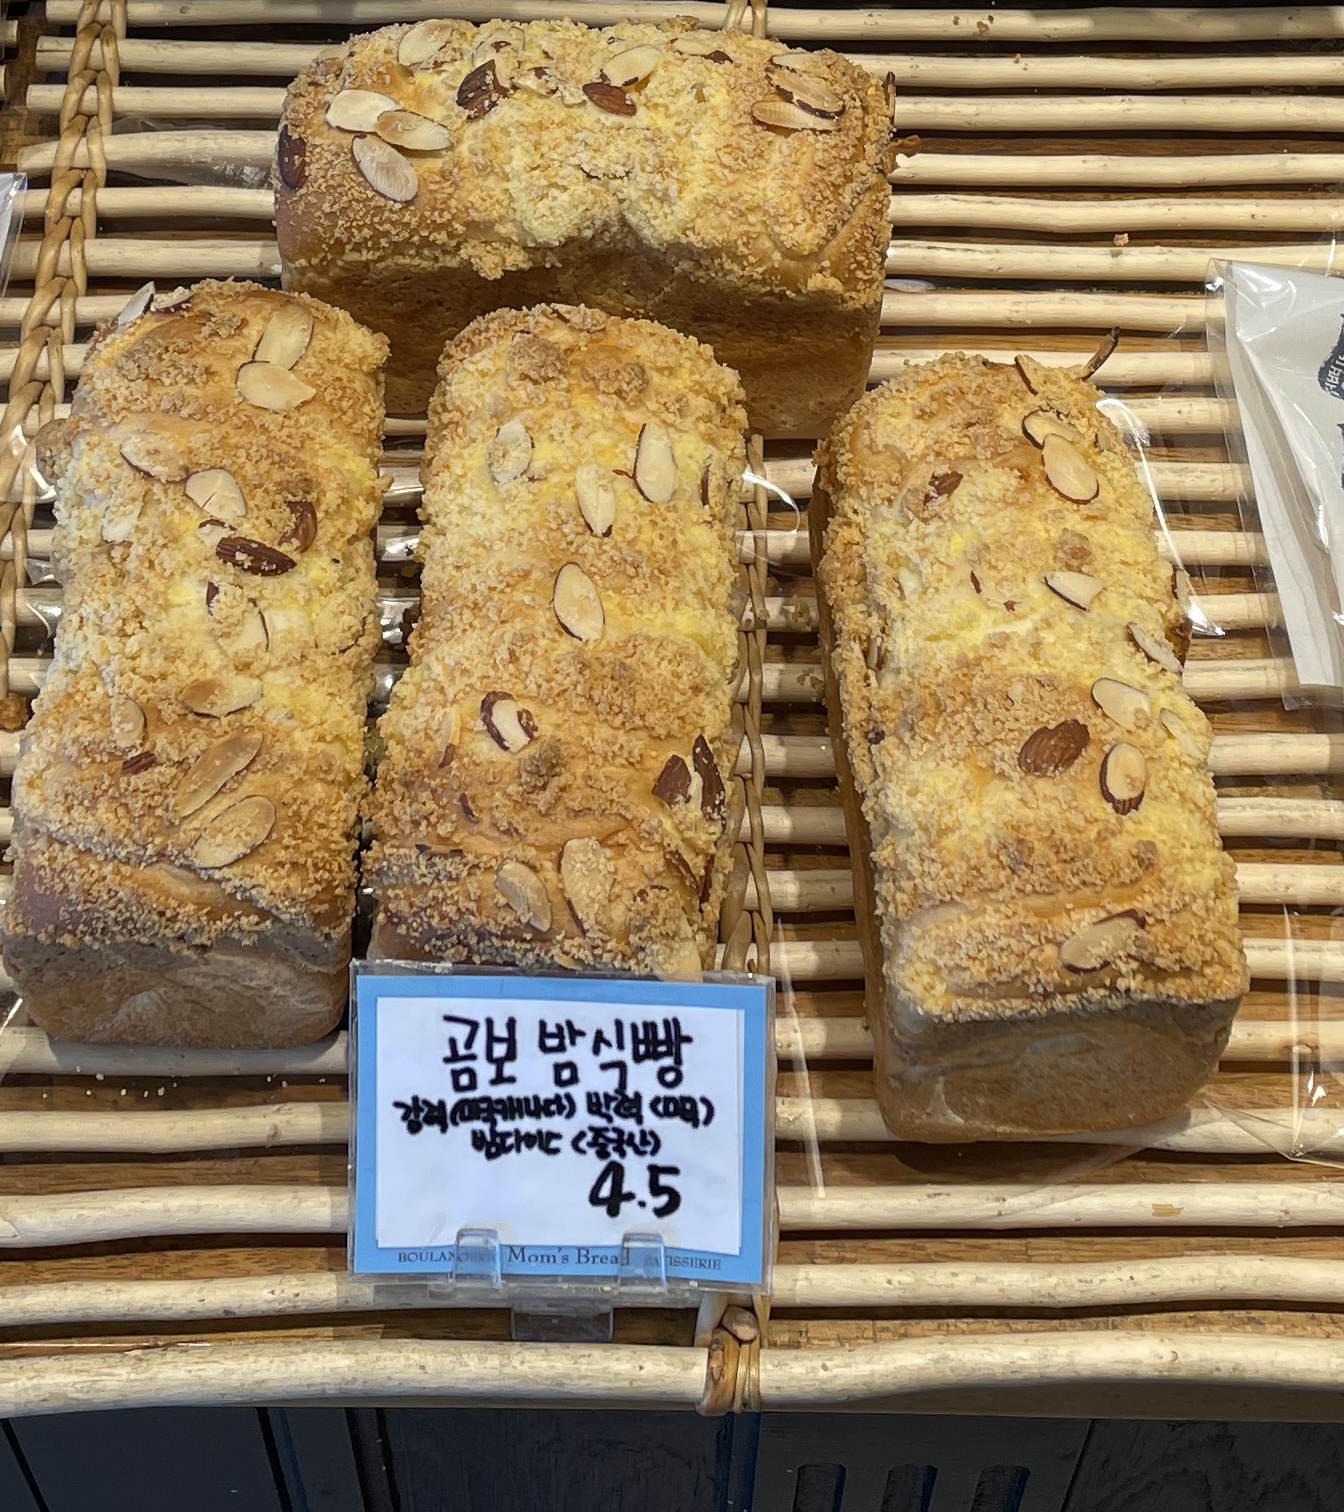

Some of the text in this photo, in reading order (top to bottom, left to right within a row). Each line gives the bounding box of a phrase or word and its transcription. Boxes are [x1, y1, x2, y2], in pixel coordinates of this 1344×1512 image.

[442, 1014, 518, 1092] 곰보
[589, 1159, 681, 1218] 4.5
[507, 1246, 569, 1265] Mom's
